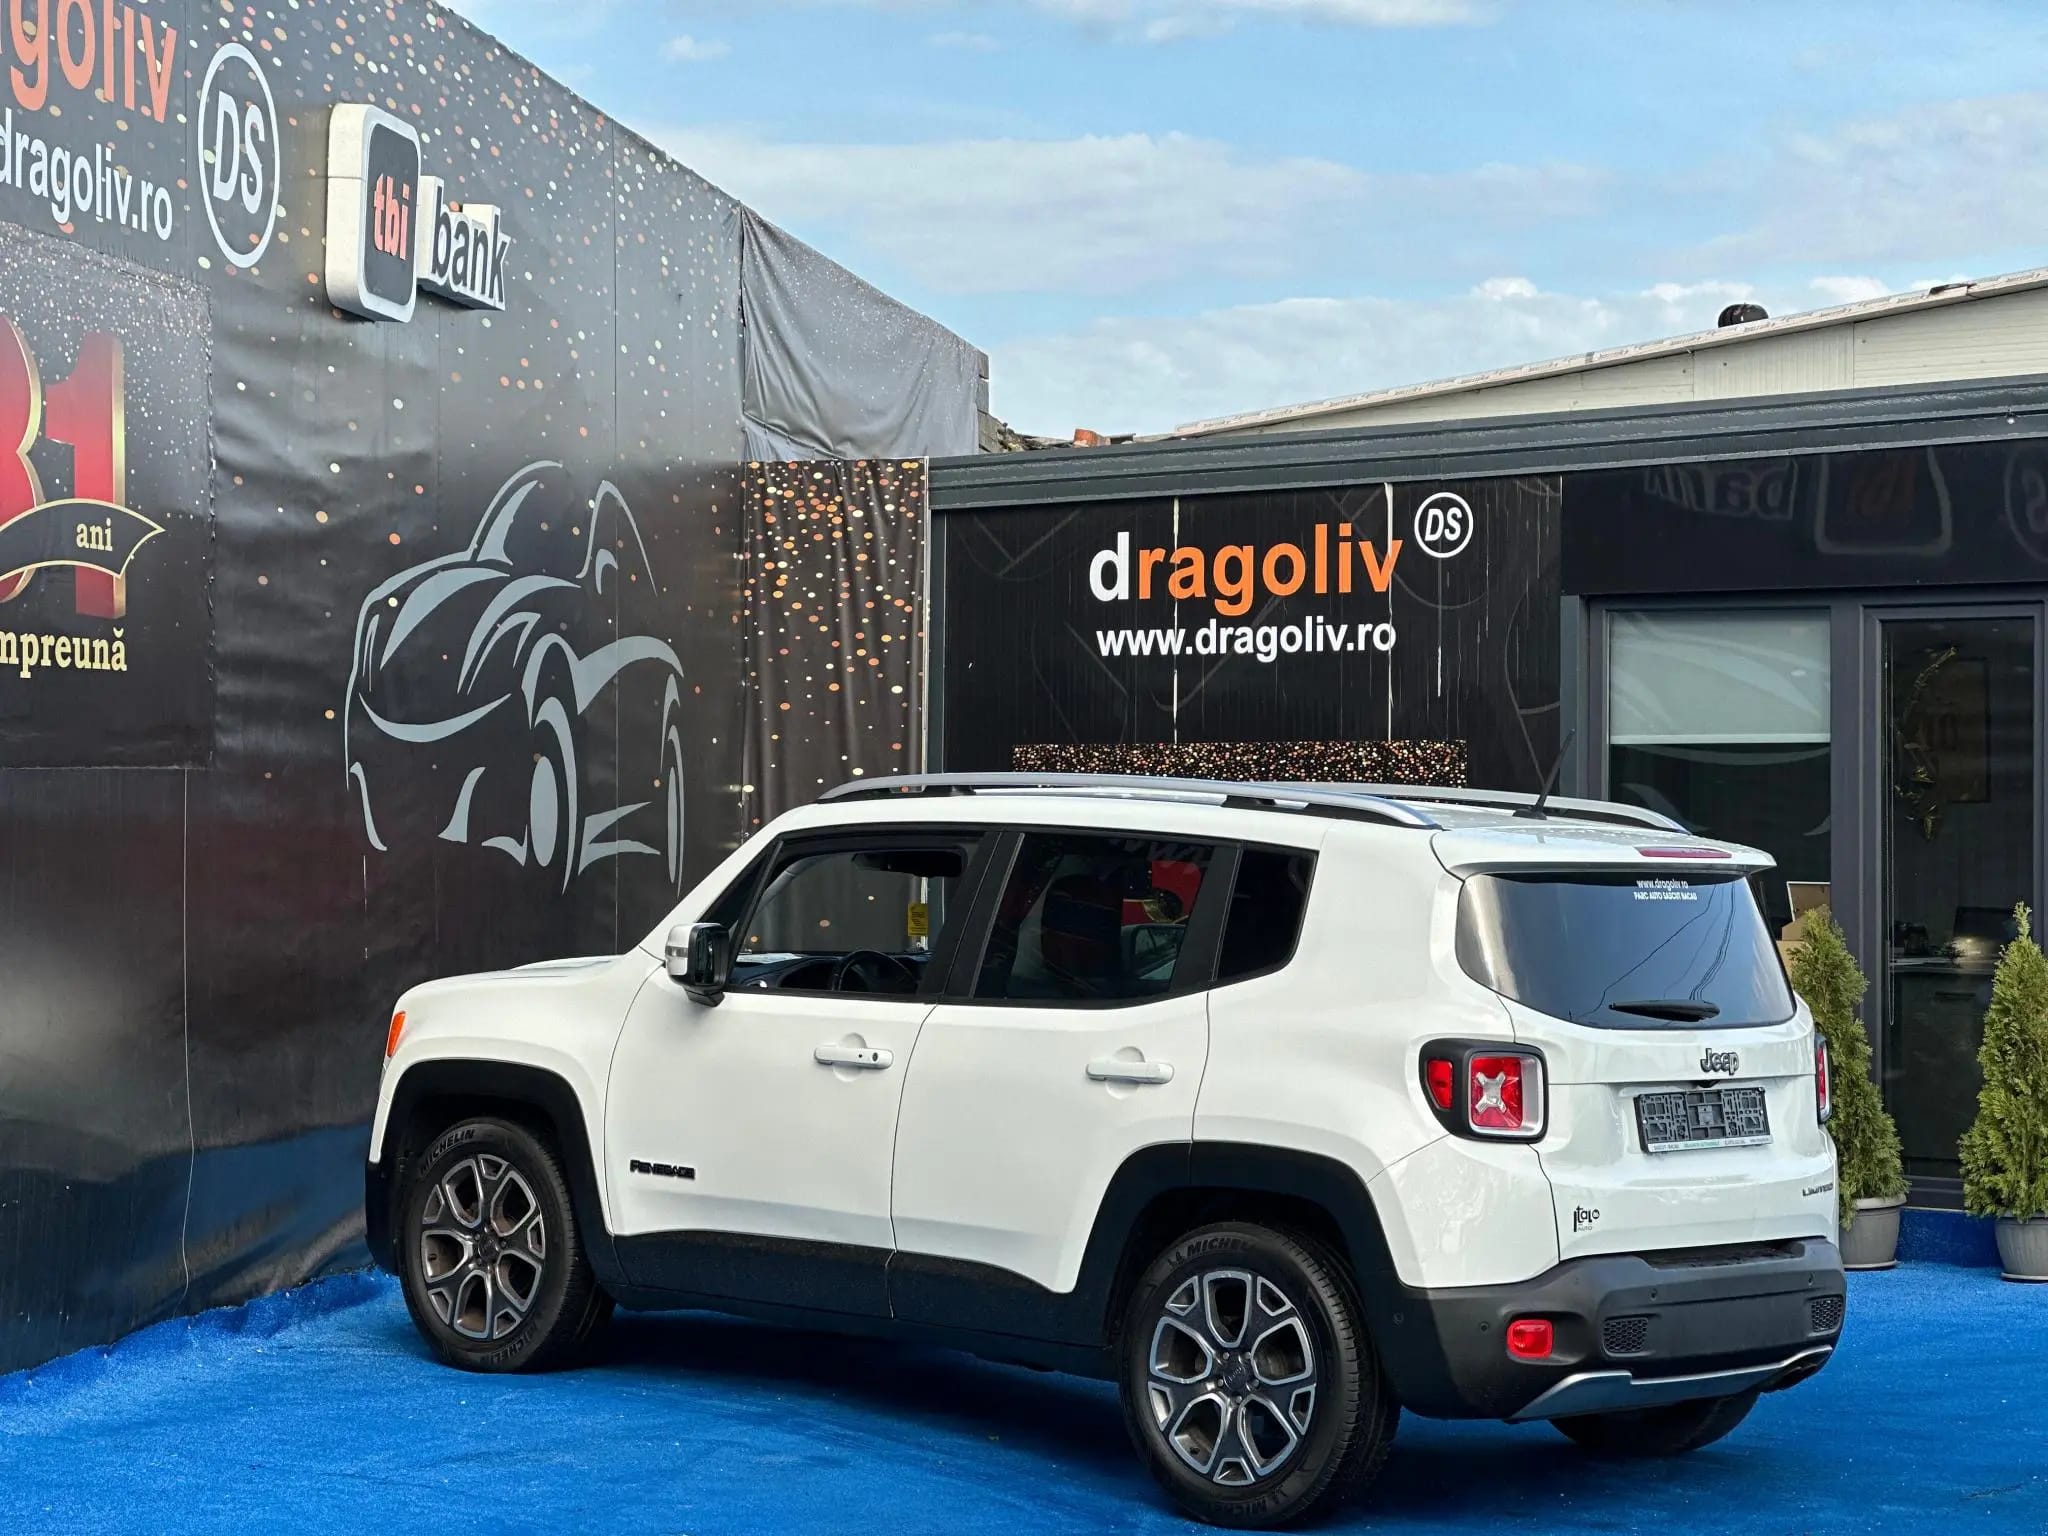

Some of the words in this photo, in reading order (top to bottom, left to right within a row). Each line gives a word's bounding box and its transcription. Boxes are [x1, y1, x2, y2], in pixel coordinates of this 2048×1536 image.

[0, 0, 177, 123] goliv
[213, 90, 265, 214] DS
[373, 172, 410, 261] tbi
[432, 185, 510, 304] bank
[76, 518, 113, 552] ani
[1424, 507, 1463, 542] DS
[1089, 522, 1404, 617] dragoliv
[1096, 615, 1397, 663] www.dragoliv.ro
[1700, 1047, 1740, 1076] Jeep
[629, 1159, 696, 1181] RENEGADE
